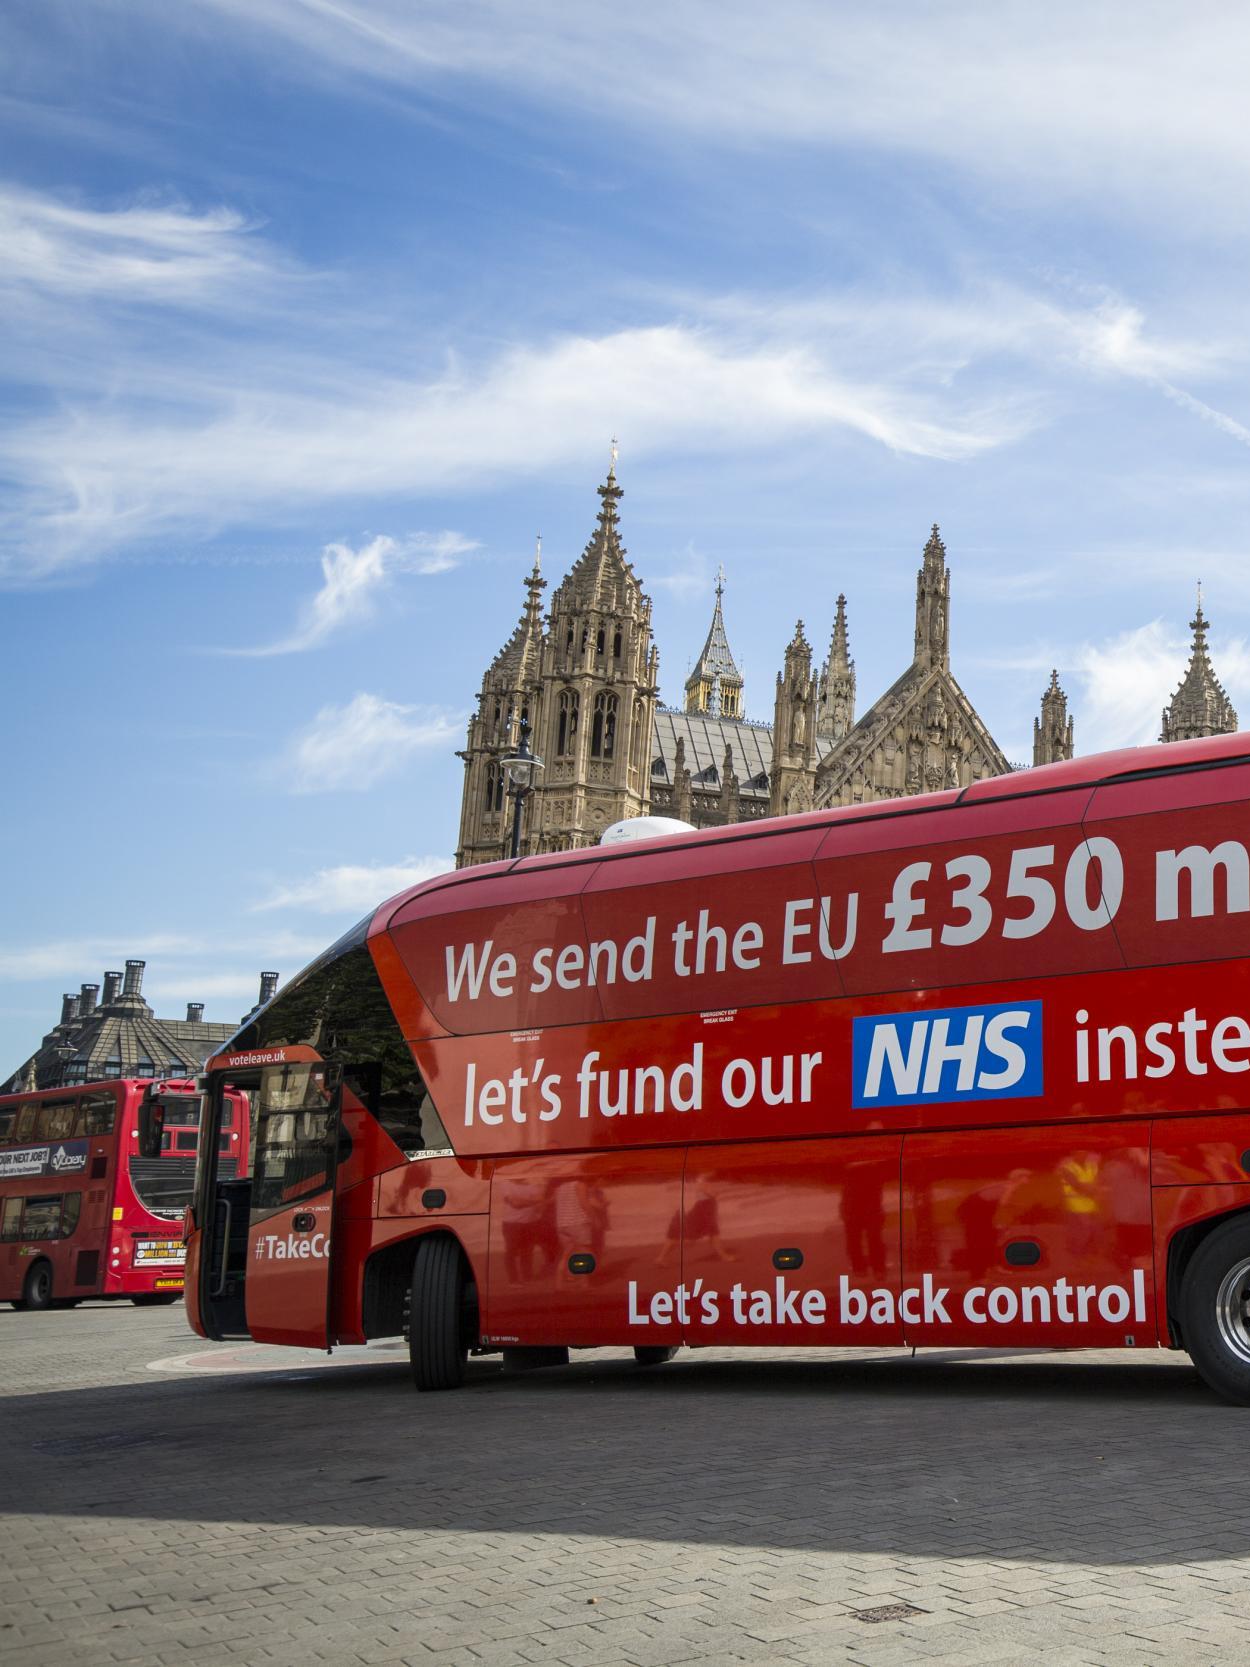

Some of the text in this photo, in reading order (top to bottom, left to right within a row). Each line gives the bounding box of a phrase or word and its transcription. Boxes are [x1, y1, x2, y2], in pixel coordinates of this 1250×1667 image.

[446, 941, 516, 1002] We
[530, 917, 656, 992] send
[672, 910, 763, 976] the
[783, 893, 858, 964] EU
[882, 837, 1123, 953] £350
[229, 1050, 286, 1066] voteleave.uk
[464, 1058, 561, 1126] let's
[577, 1043, 703, 1118] fund
[722, 1052, 822, 1107] our
[864, 1011, 1030, 1097] NHS
[629, 1269, 1145, 1324] Let's take back control
